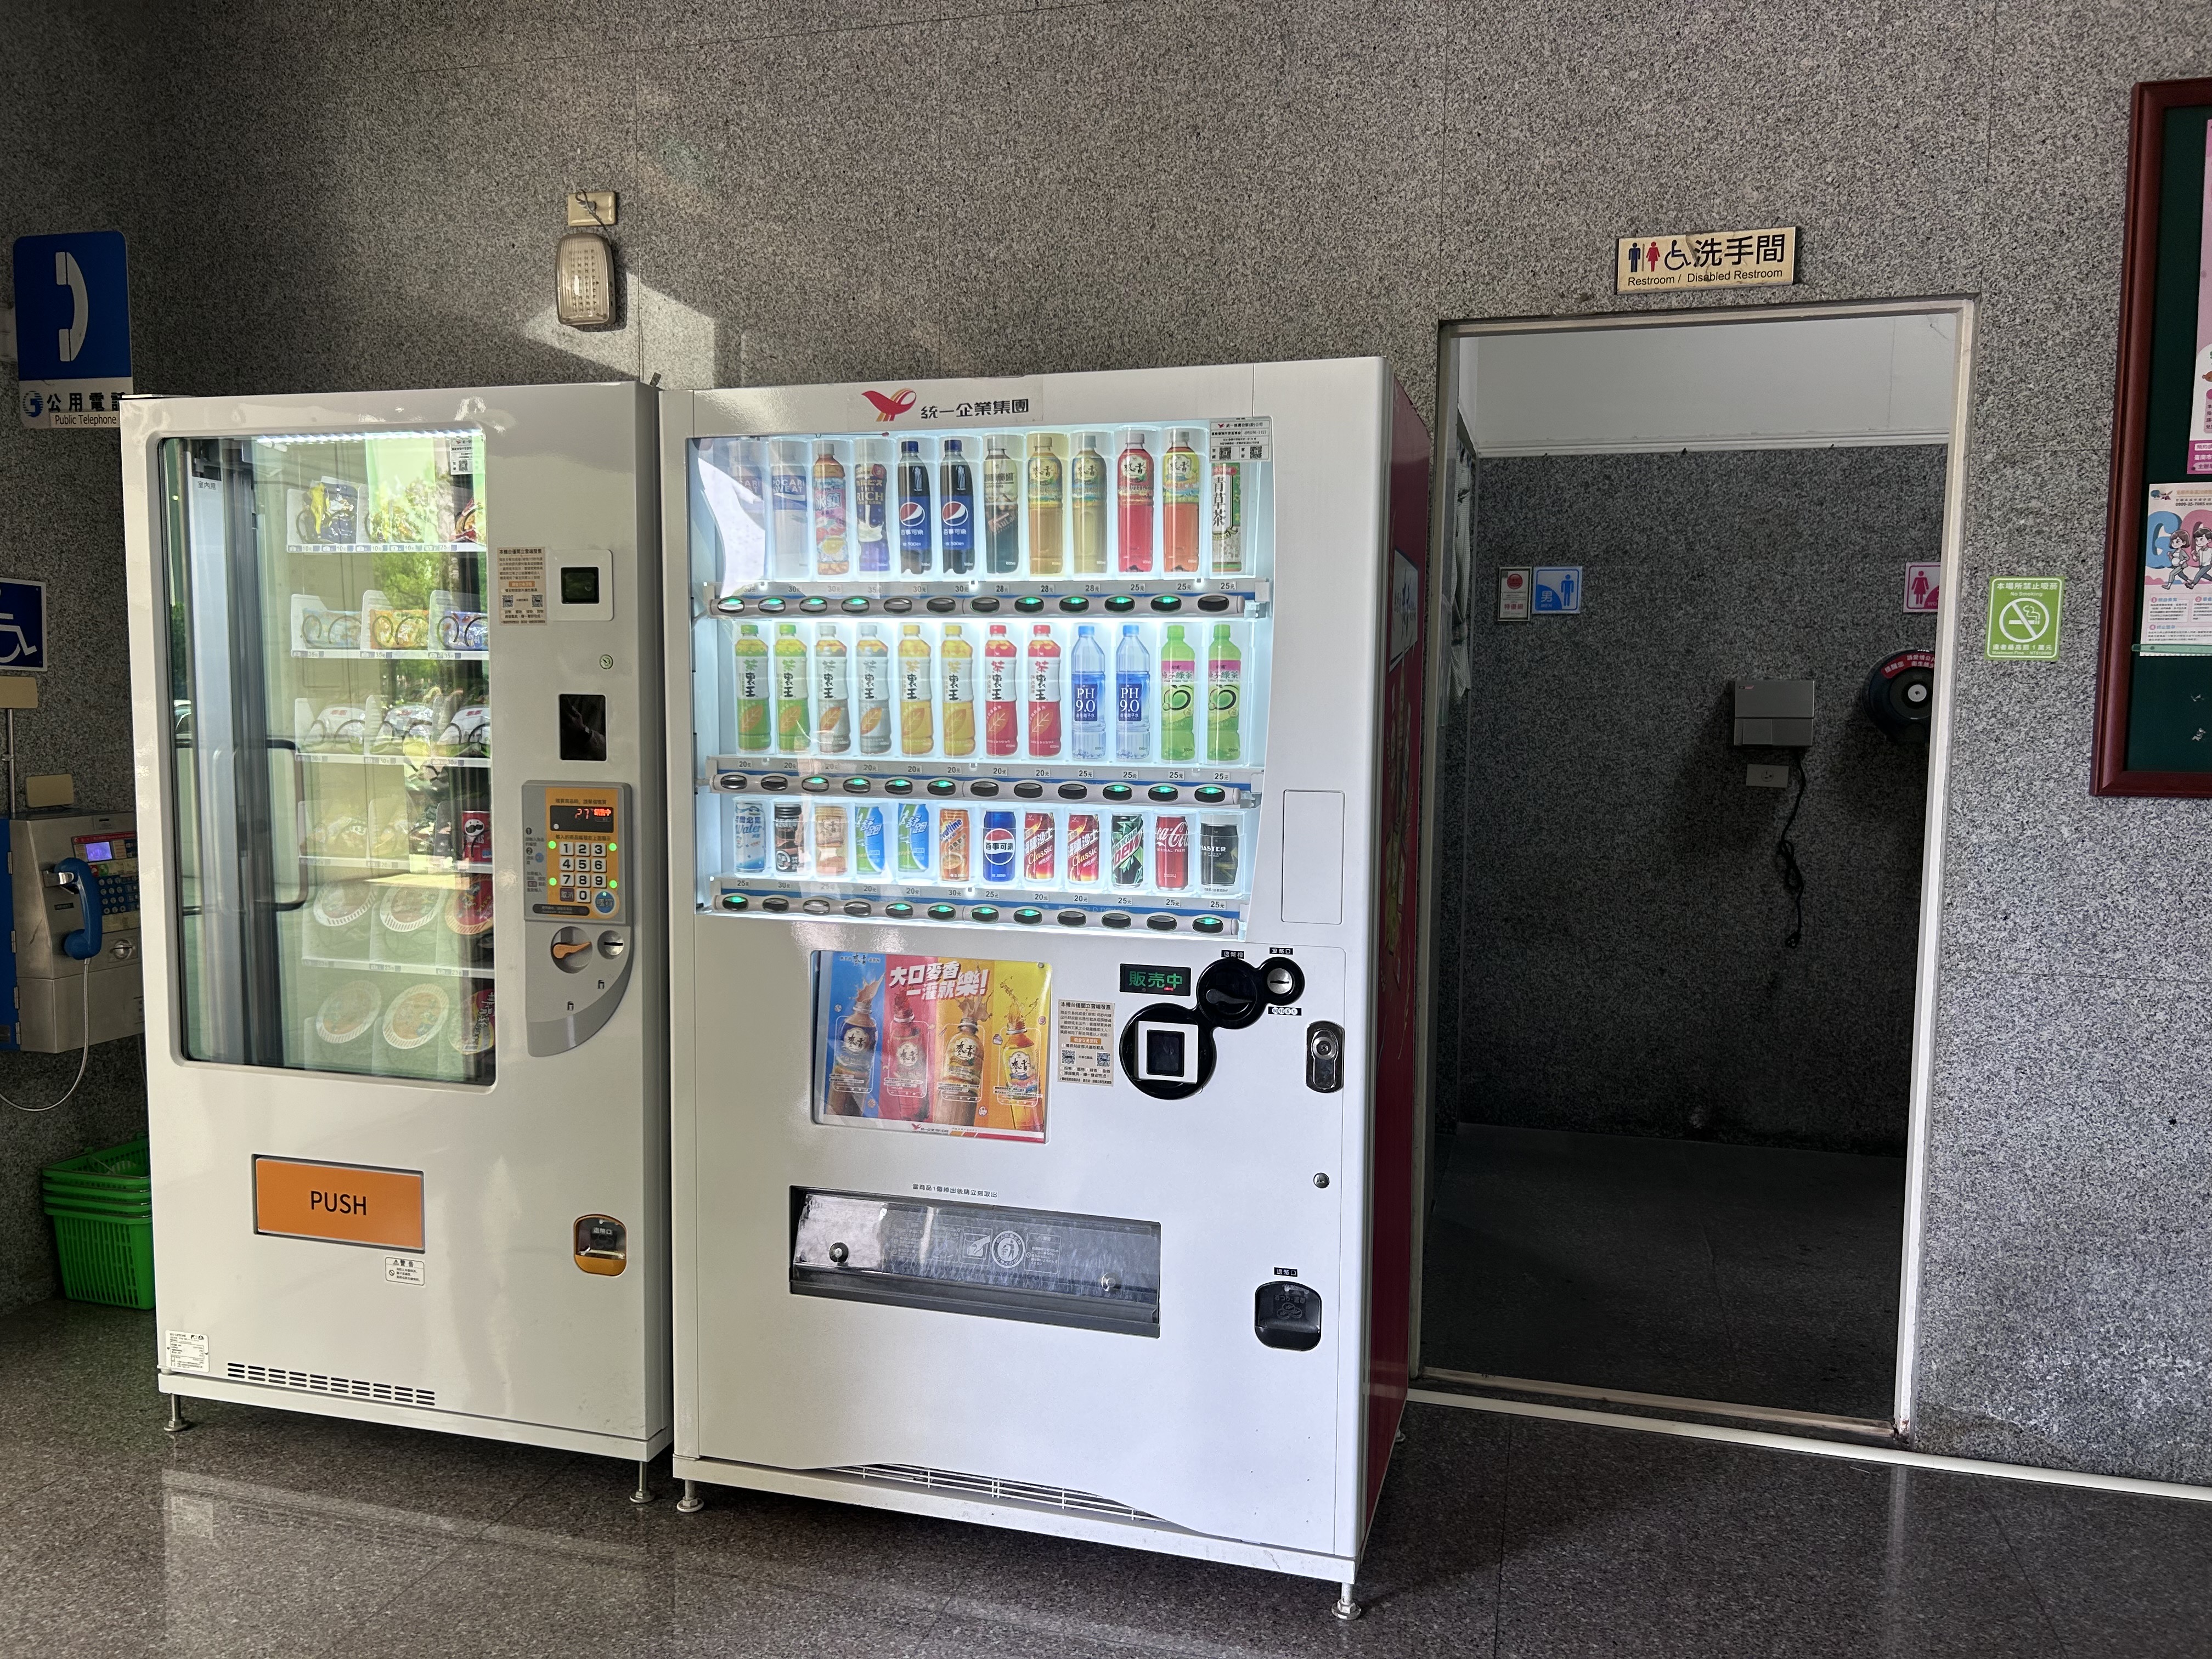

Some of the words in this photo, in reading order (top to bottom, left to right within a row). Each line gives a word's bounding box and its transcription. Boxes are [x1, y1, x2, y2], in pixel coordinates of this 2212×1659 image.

[1693, 233, 1785, 268] 洗手間
[1628, 276, 1675, 286] Restroom
[1688, 273, 1730, 283] Disabled
[1734, 269, 1782, 280] Restroom
[921, 398, 1029, 420] 統一企業集團
[55, 414, 77, 425] Public
[78, 414, 117, 426] Telephone
[856, 492, 884, 501] RICH
[1212, 476, 1226, 527] 青草茶
[1085, 584, 1100, 592] 28元
[1130, 583, 1146, 591] 25元
[1177, 583, 1192, 591] 25元
[1220, 582, 1235, 590] 25元
[1541, 590, 1553, 602] 男
[1077, 688, 1094, 699] PH
[1121, 688, 1139, 699] PH
[1075, 700, 1096, 713] 9.0
[1120, 700, 1140, 713] 9.0
[738, 760, 752, 769] 20元
[1035, 769, 1050, 777] 20元
[1079, 770, 1093, 778] 25元
[1123, 771, 1137, 780] 25元
[1169, 771, 1184, 780] 25元
[1214, 772, 1229, 781] 25元
[860, 817, 882, 837] 舒跑
[905, 815, 928, 834] 舒跑
[563, 843, 569, 853] 1
[578, 844, 587, 854] 2
[594, 844, 603, 855] 3
[985, 842, 1013, 850] 百事可樂
[1028, 845, 1053, 865] Classic
[1072, 847, 1098, 867] Classic
[562, 859, 571, 869] 4
[578, 859, 587, 869] 5
[594, 860, 603, 870] 6
[562, 874, 572, 884] 7
[578, 875, 588, 885] 8
[595, 876, 603, 886] 9
[777, 881, 791, 889] 30元
[579, 890, 587, 900] 0
[906, 887, 919, 895] 20元
[947, 889, 962, 897] 30元
[985, 890, 999, 899] 25元
[1034, 893, 1048, 901] 20元
[1074, 895, 1088, 903] 20元
[1117, 896, 1132, 905] 25元
[1165, 899, 1180, 907] 25元
[1210, 900, 1225, 909] 25元
[889, 961, 961, 988] 大口麥香
[1128, 970, 1183, 989] 販売中
[906, 969, 990, 1000] 一灌就樂!
[311, 1190, 367, 1216] PUSH
